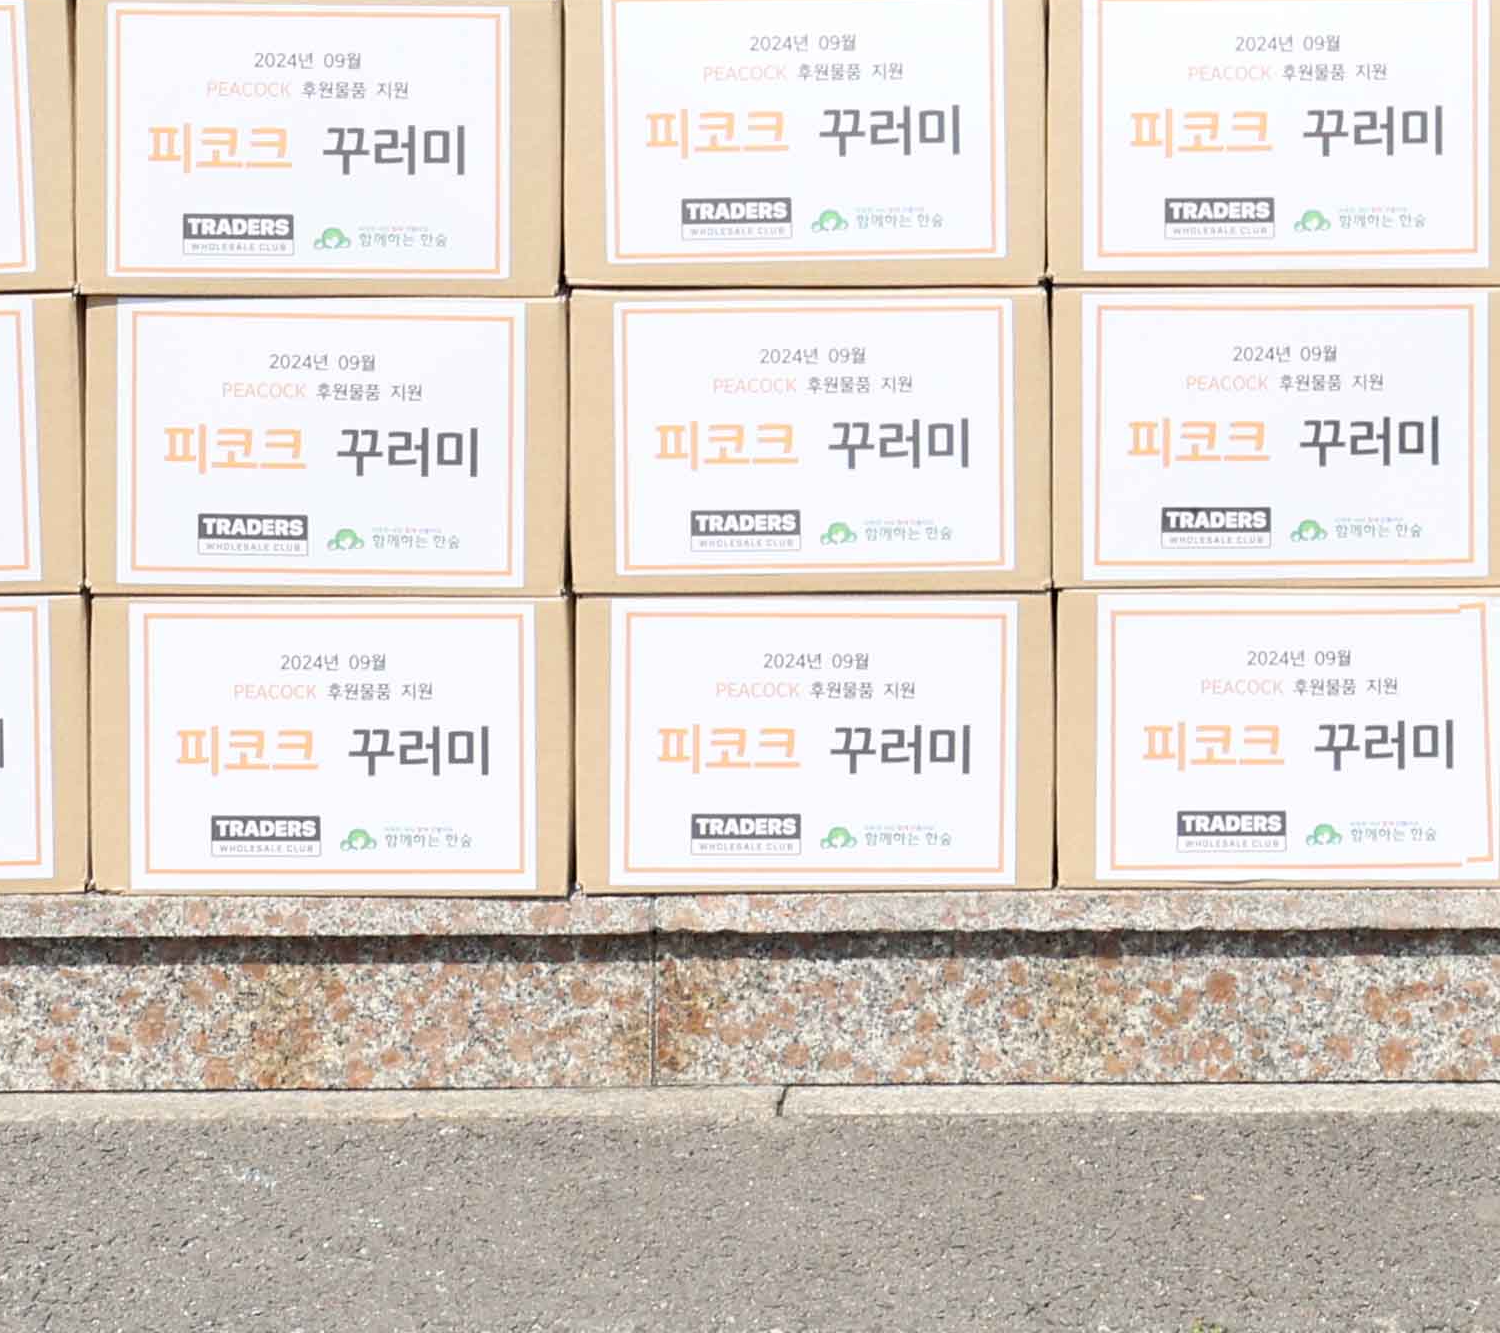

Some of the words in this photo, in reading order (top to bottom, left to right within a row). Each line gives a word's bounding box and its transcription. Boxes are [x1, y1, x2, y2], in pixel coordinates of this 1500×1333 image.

[1235, 34, 1293, 54] 2024년
[1303, 34, 1341, 54] 09월
[1188, 65, 1272, 82] PEACOCK
[1282, 62, 1344, 83] 후원물품
[1355, 62, 1388, 83] 지원
[1130, 107, 1274, 157] 피코크
[1303, 104, 1443, 157] 꾸러미
[1169, 200, 1271, 221] TRADERS
[1337, 211, 1393, 231] 함께하는
[1400, 211, 1427, 229] 한숲
